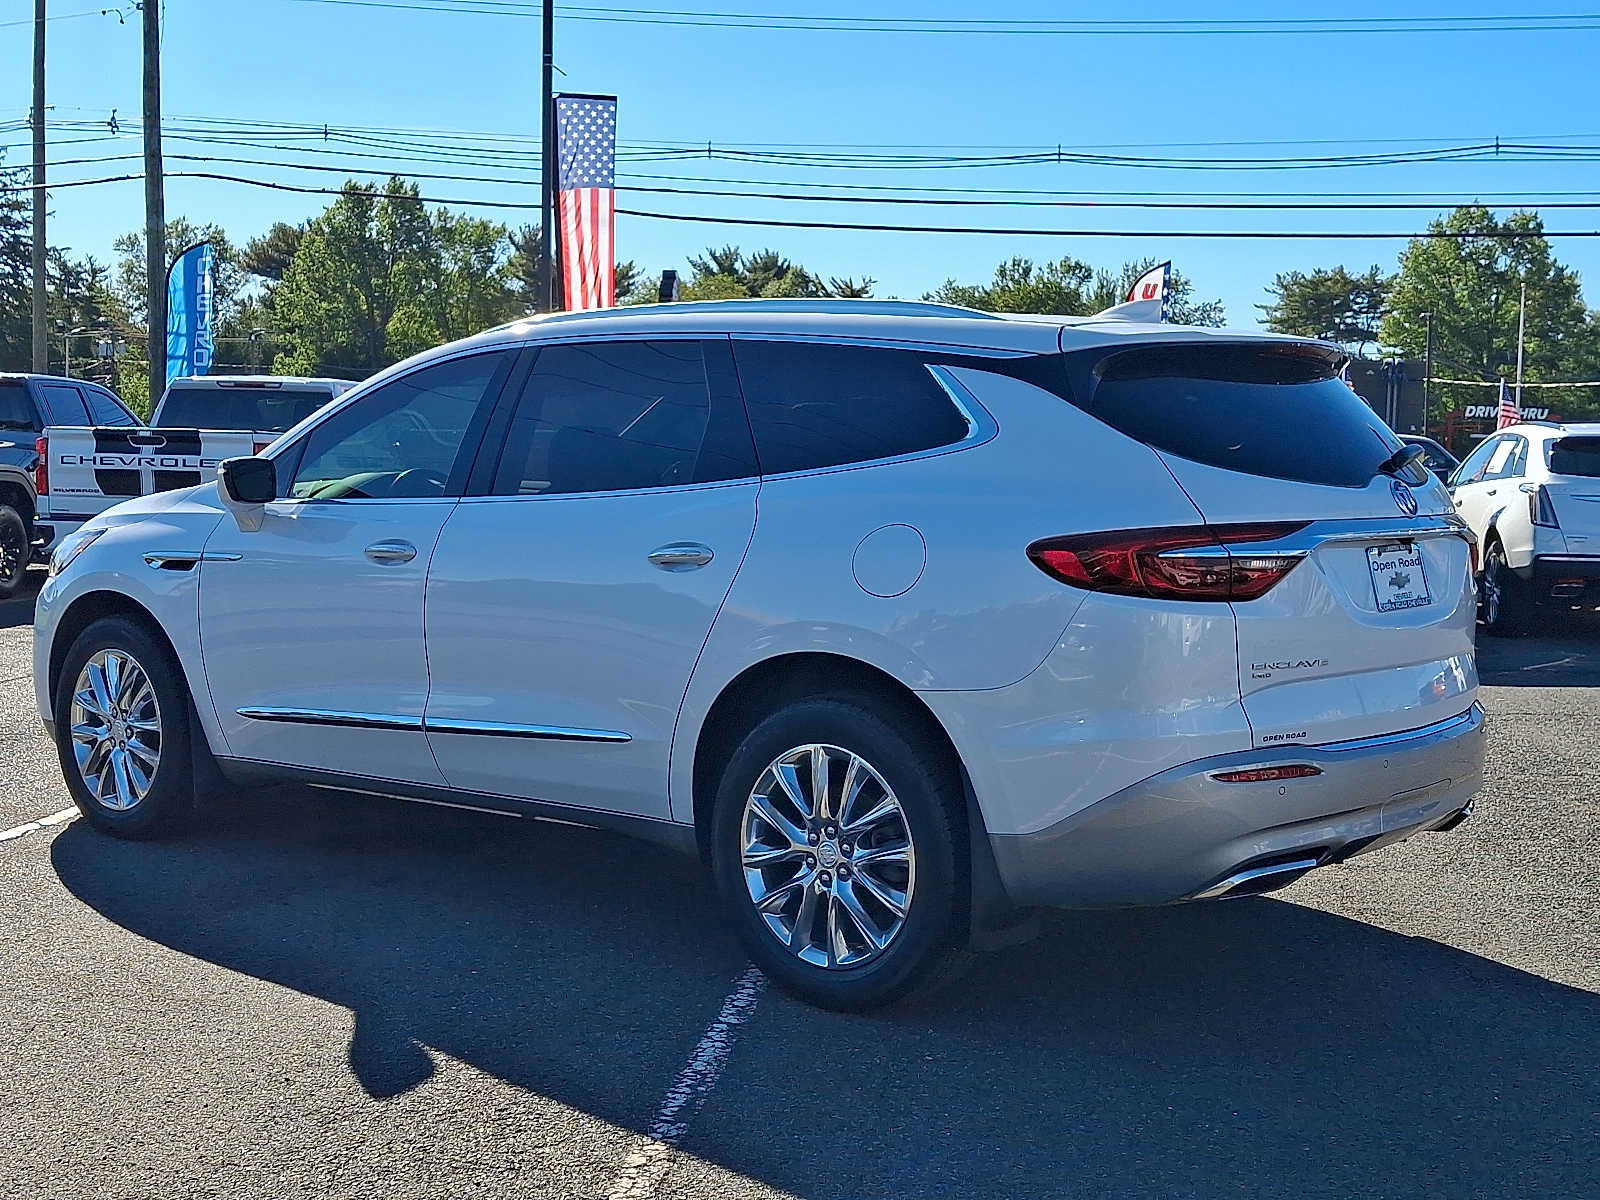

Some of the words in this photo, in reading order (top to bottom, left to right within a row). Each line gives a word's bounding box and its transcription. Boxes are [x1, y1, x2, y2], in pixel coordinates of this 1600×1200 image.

[1464, 405, 1501, 419] DRIV
[1518, 407, 1550, 420] HRU
[1371, 560, 1397, 574] Open
[1398, 556, 1421, 569] Road
[1251, 659, 1329, 671] ENCLAVE
[1262, 734, 1285, 743] OPEN
[1286, 731, 1307, 740] ROAD
